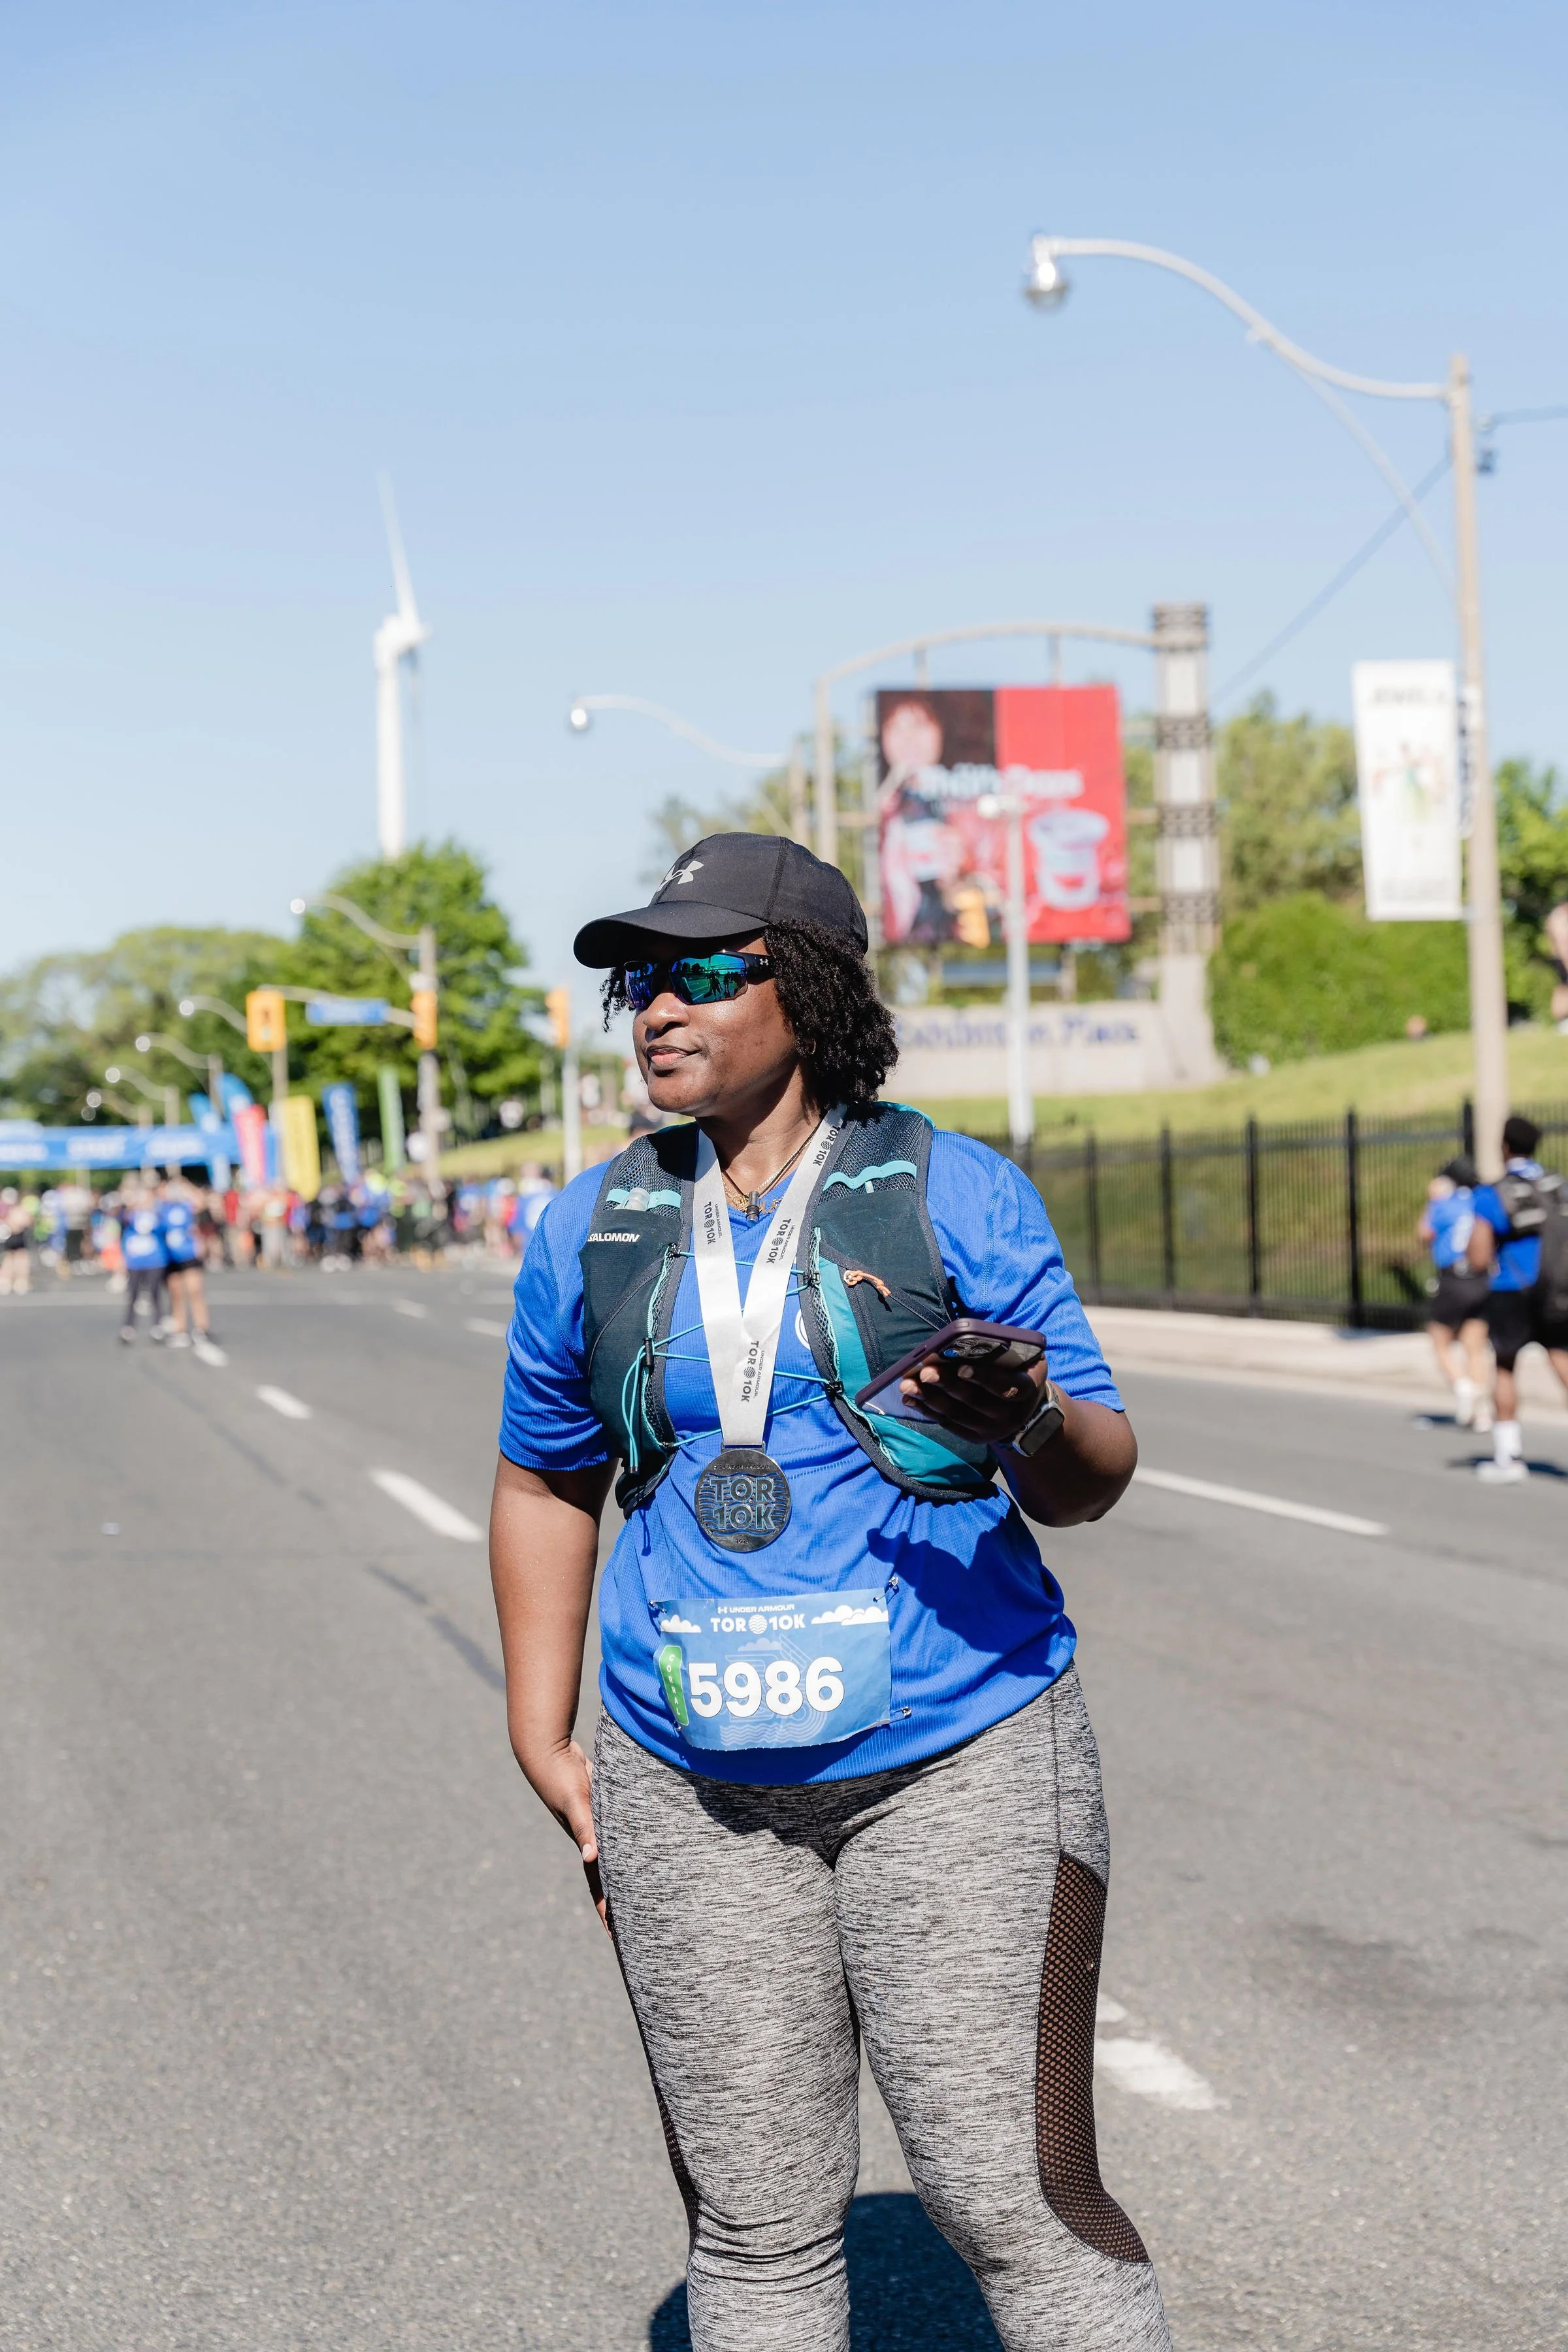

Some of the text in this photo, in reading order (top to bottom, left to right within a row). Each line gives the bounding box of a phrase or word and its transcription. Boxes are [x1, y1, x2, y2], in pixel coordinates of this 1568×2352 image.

[813, 1125, 841, 1166] TOR 10K
[587, 1232, 640, 1243] SALOMON
[704, 1201, 716, 1245] TOR 10K
[766, 1218, 792, 1264] TOR 10K
[741, 1341, 759, 1403] TOR 10K
[710, 1477, 776, 1503] TOR
[712, 1504, 776, 1529] 10K
[710, 1614, 806, 1633] TOR 10K
[757, 1604, 795, 1612] ARMOUR
[666, 1654, 681, 1716] CORRAL
[688, 1656, 845, 1718] 5986
